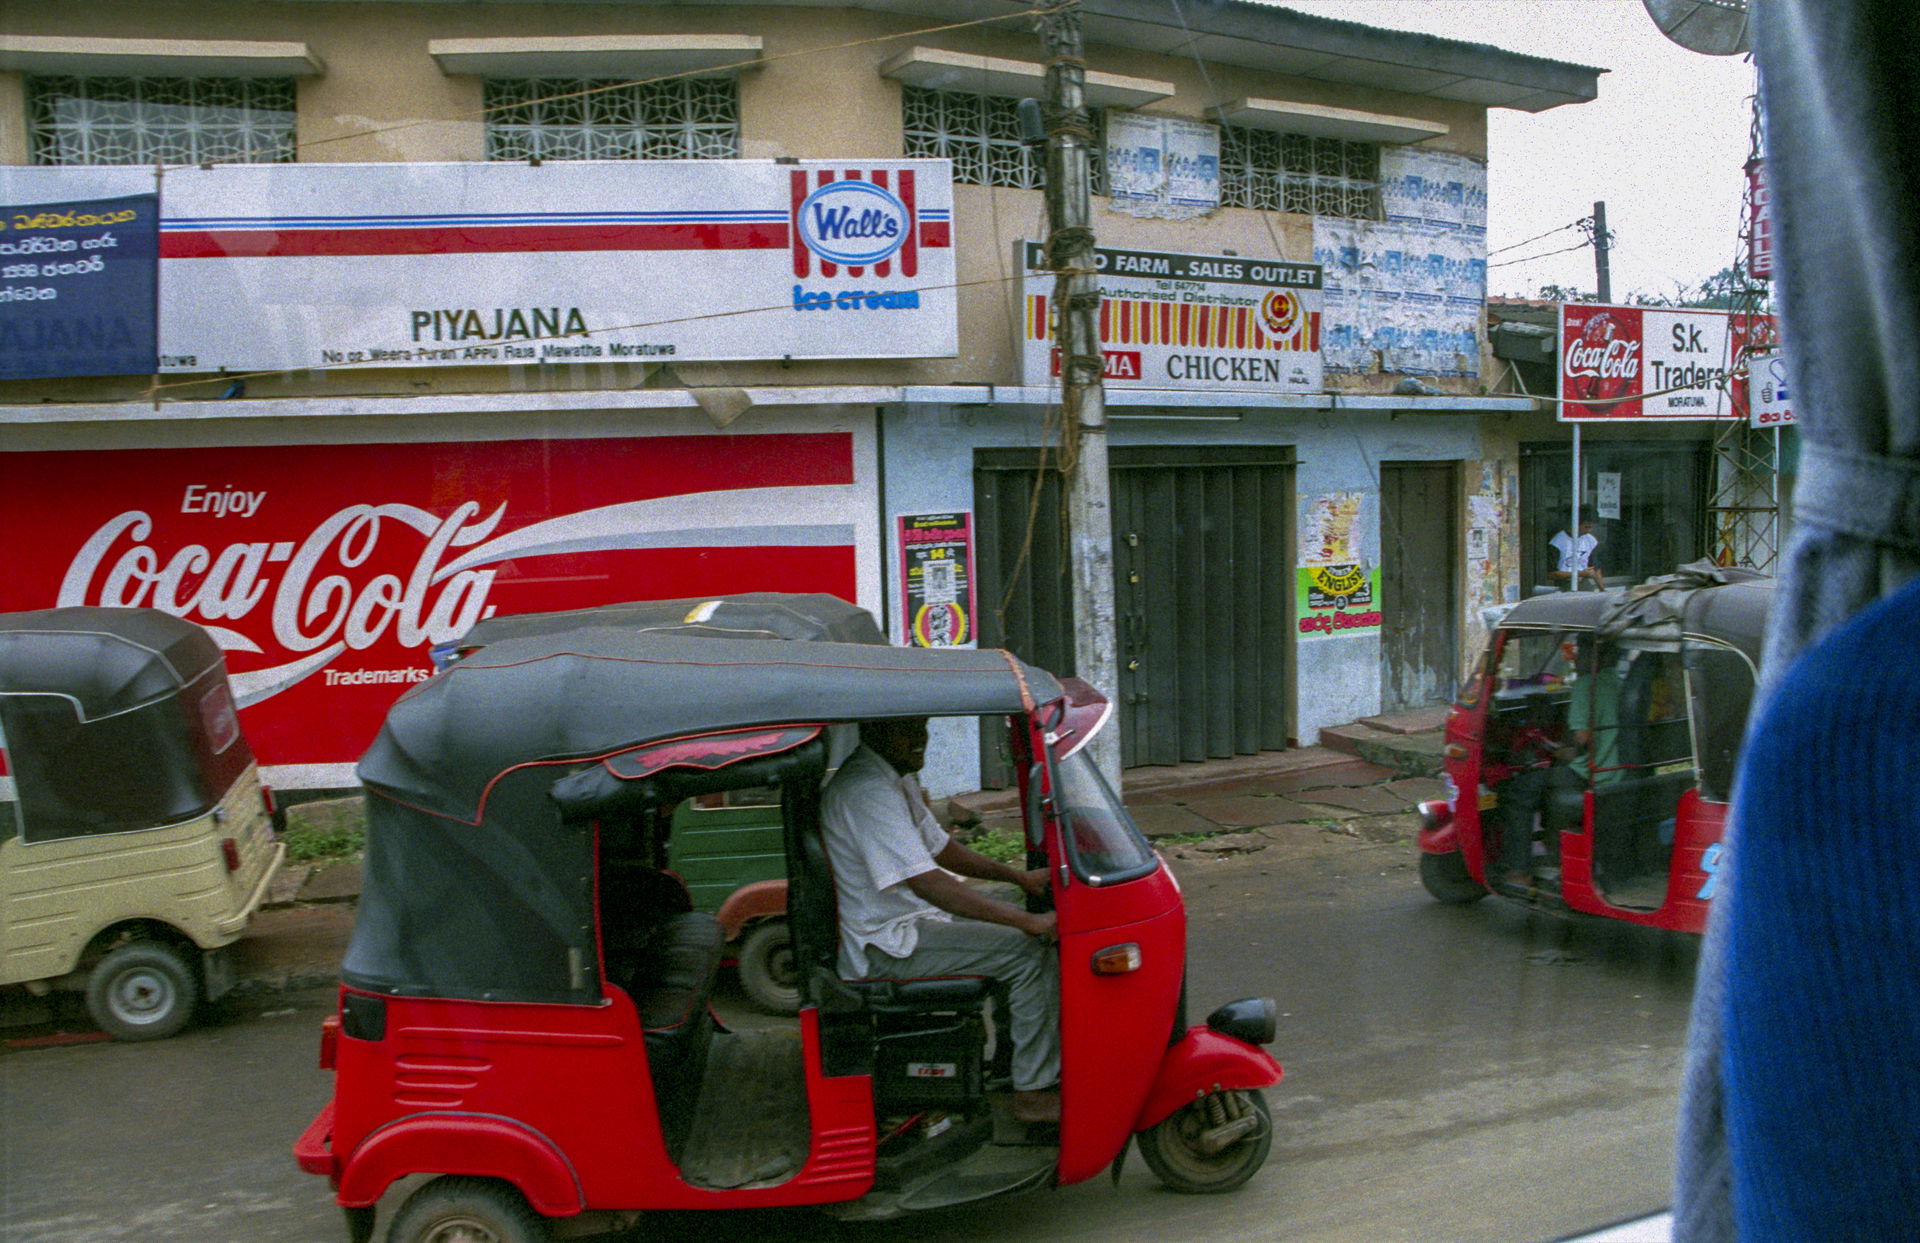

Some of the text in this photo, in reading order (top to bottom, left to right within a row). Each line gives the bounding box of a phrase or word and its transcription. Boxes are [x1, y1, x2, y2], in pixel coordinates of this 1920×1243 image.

[812, 202, 899, 241] Wall's
[1115, 255, 1170, 274] FARM
[1188, 261, 1244, 279] SALES
[1250, 267, 1317, 285] OUTLET
[1099, 286, 1259, 307] Authorised Distributor
[411, 307, 590, 341] PIYAJANA
[322, 350, 343, 363] No
[609, 342, 676, 356] Moratuwa
[1565, 338, 1640, 380] Coca-Cola
[1167, 354, 1281, 383] CHICKEN
[1651, 361, 1725, 391] Traders
[181, 484, 266, 518] Enjoy
[56, 500, 508, 652] Coca-Cola
[324, 666, 430, 687] Trademarks
